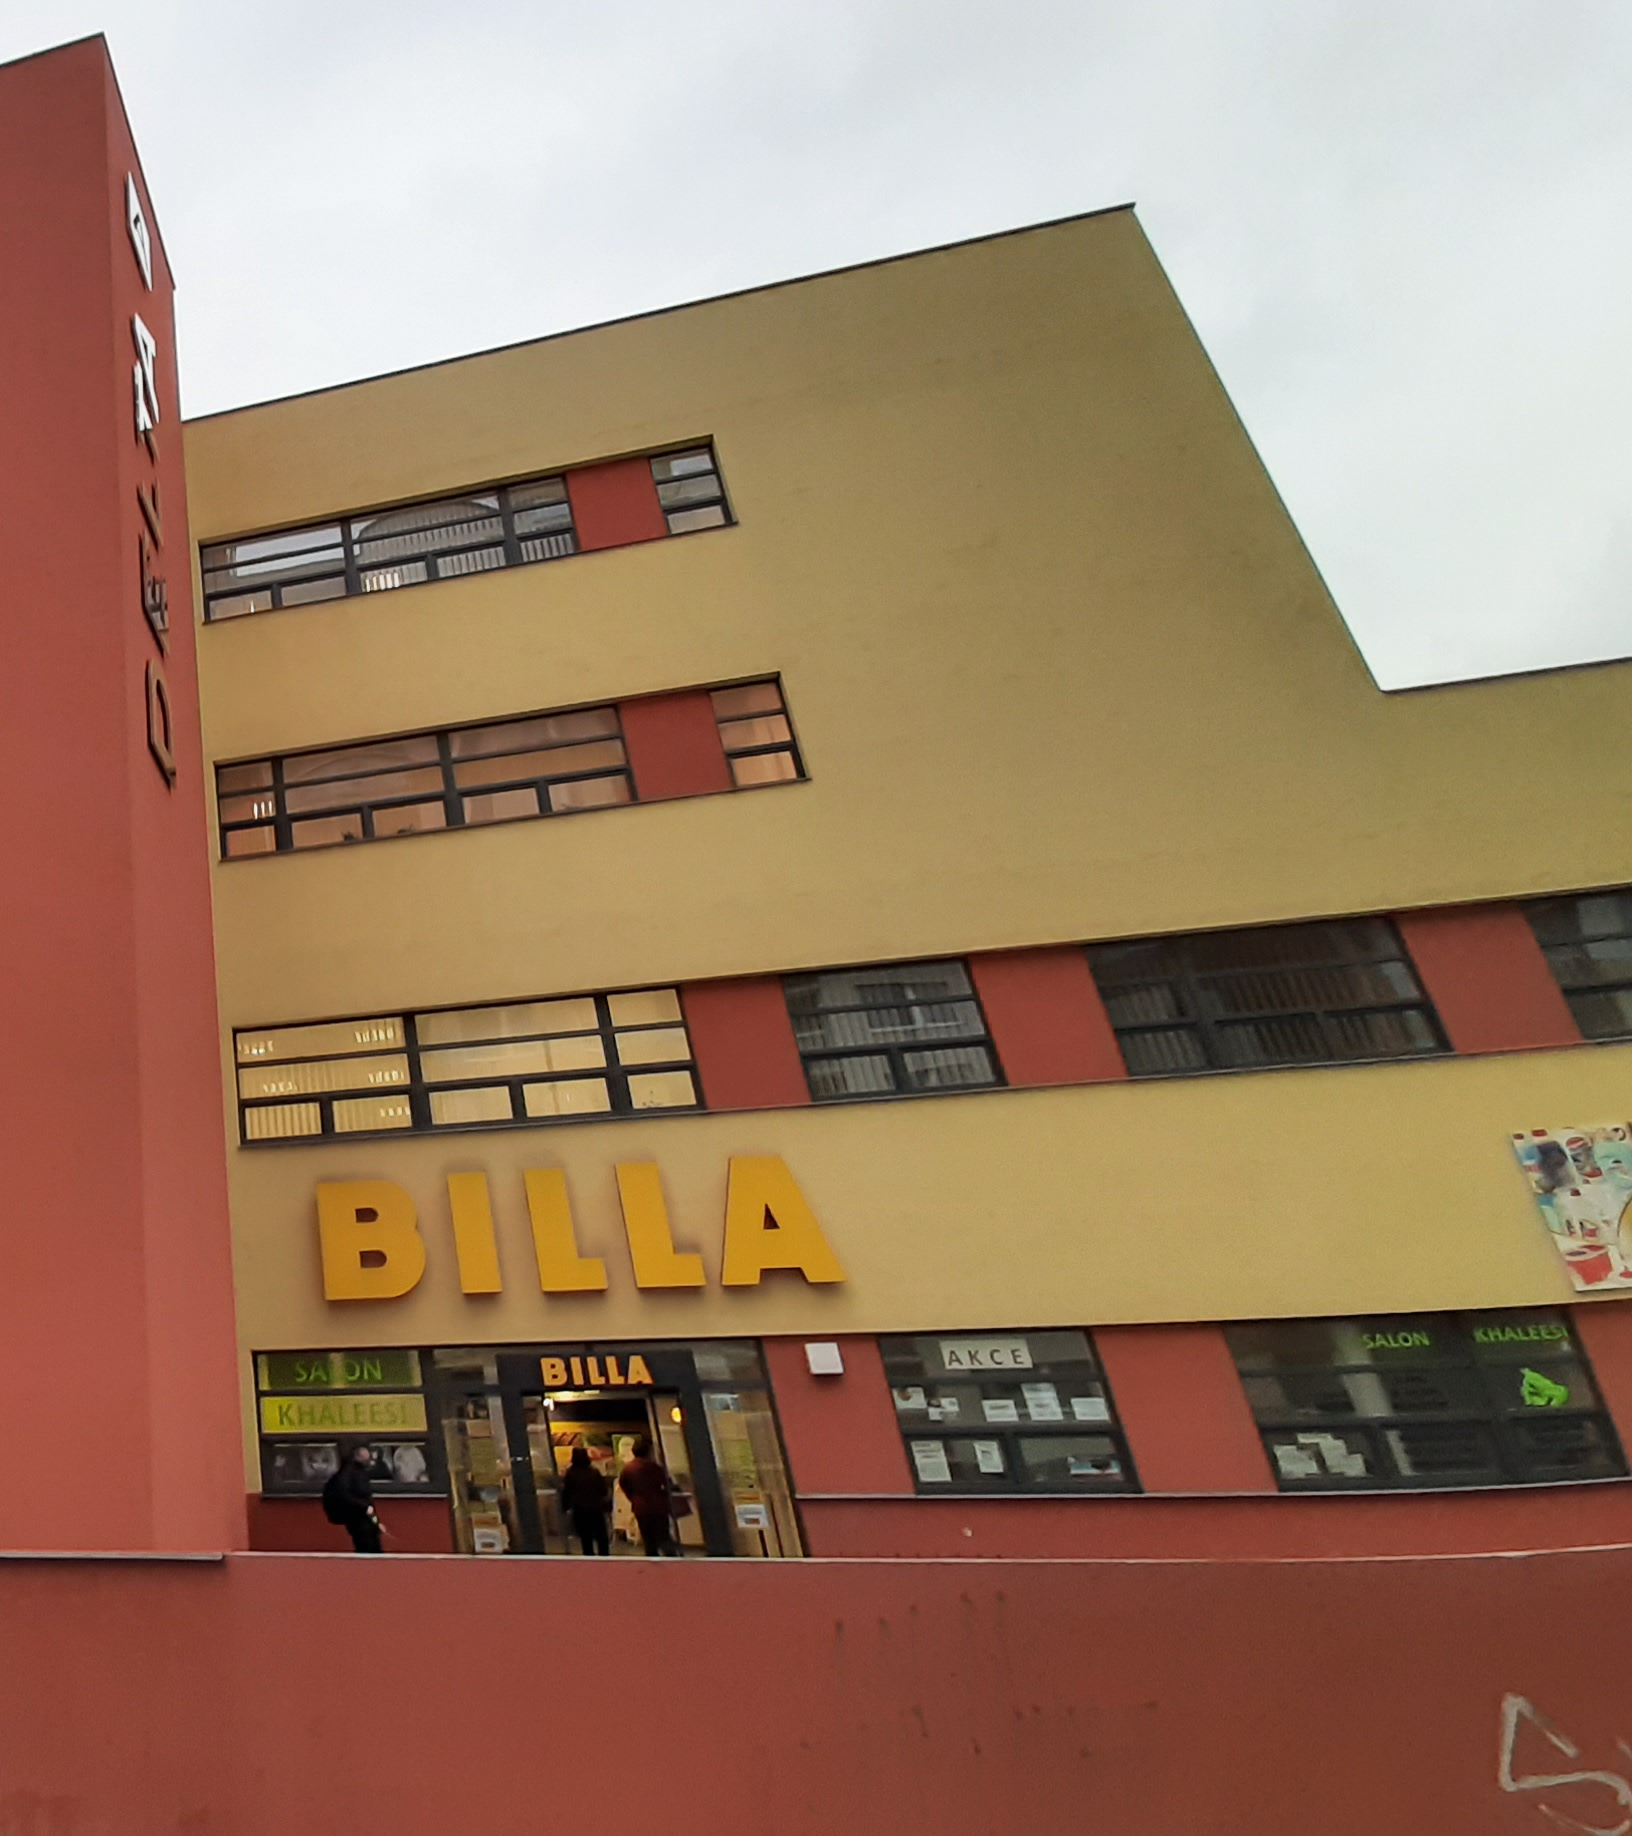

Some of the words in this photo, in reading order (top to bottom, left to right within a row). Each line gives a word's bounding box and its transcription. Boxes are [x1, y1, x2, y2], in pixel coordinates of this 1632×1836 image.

[315, 1156, 846, 1301] BILLA
[1362, 1330, 1430, 1347] SALON
[947, 1348, 1025, 1367] AKCE
[295, 1359, 382, 1382] SAON
[540, 1355, 654, 1387] BILLA
[277, 1400, 406, 1427] KHALEESI
